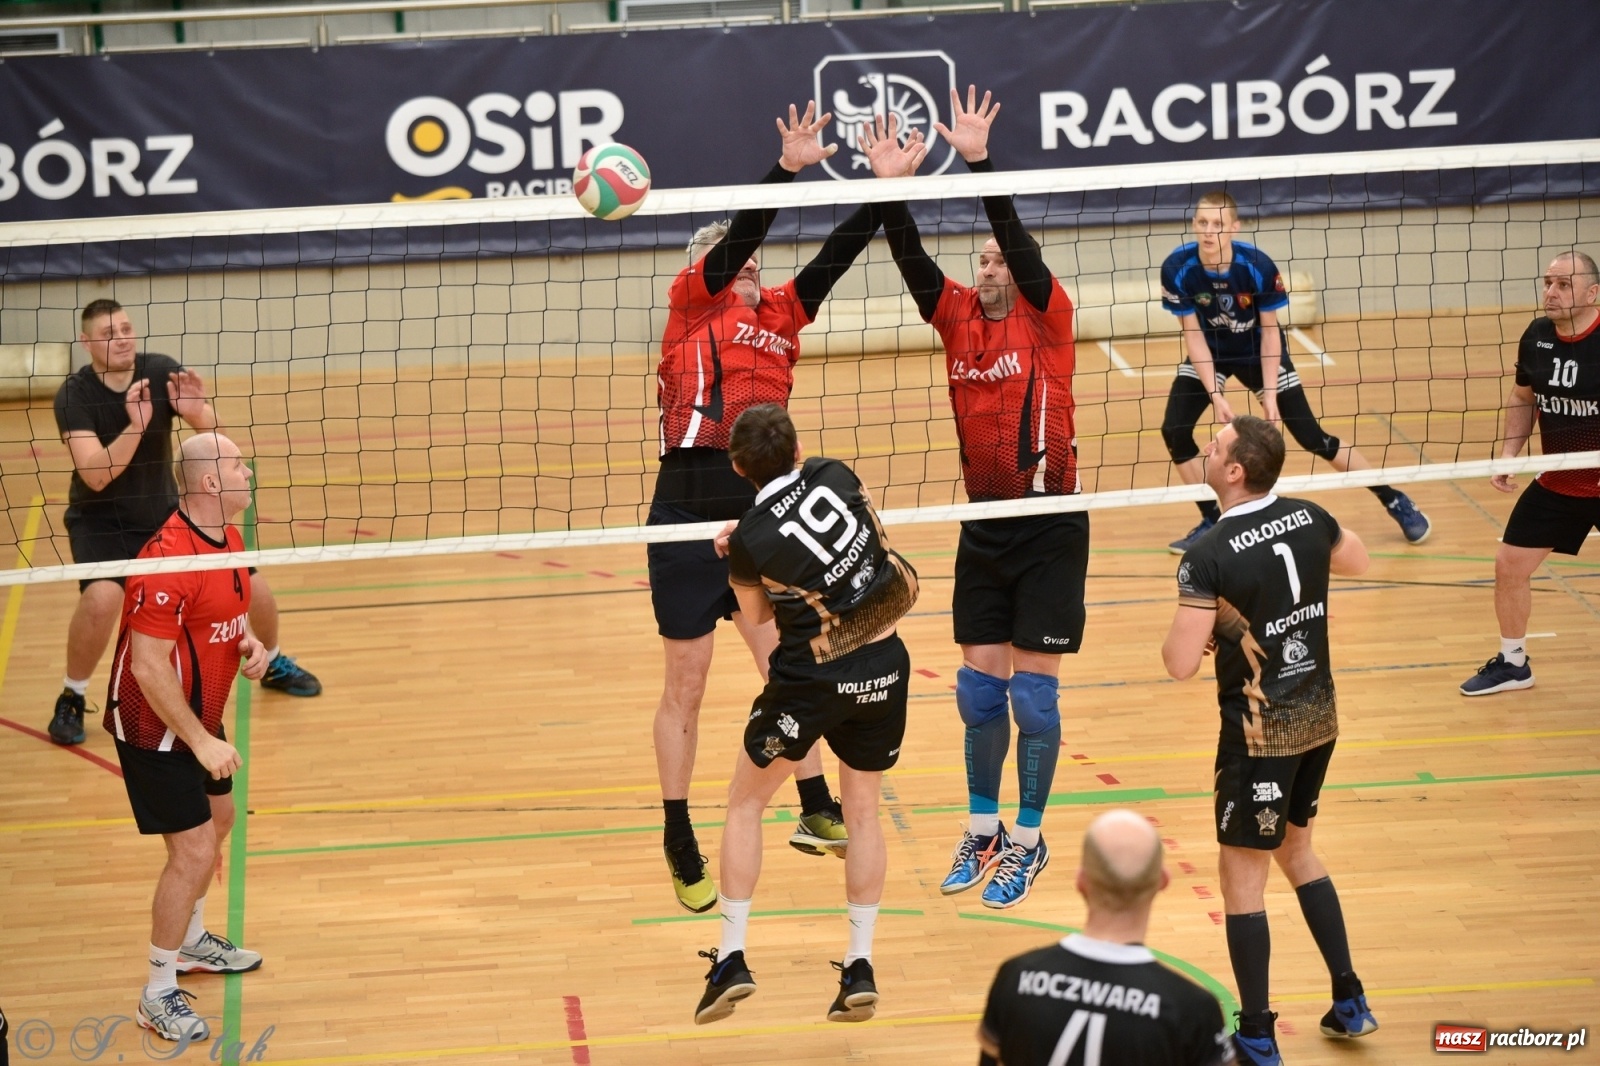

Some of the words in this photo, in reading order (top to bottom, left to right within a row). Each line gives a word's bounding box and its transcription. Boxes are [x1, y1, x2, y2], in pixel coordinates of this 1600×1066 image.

[1039, 55, 1458, 151] RACIBÓRZ
[486, 177, 576, 198] RACIB
[615, 160, 639, 185] MECZ
[1548, 357, 1578, 388] 10
[778, 485, 858, 566] 19
[1229, 508, 1313, 553] KOŁODZIEJ
[823, 524, 871, 587] AGROTIM
[1272, 542, 1301, 605] 1
[837, 670, 900, 695] VOLLEYBALL
[856, 689, 888, 704] TEAM
[1017, 970, 1162, 1019] KOCZWARA
